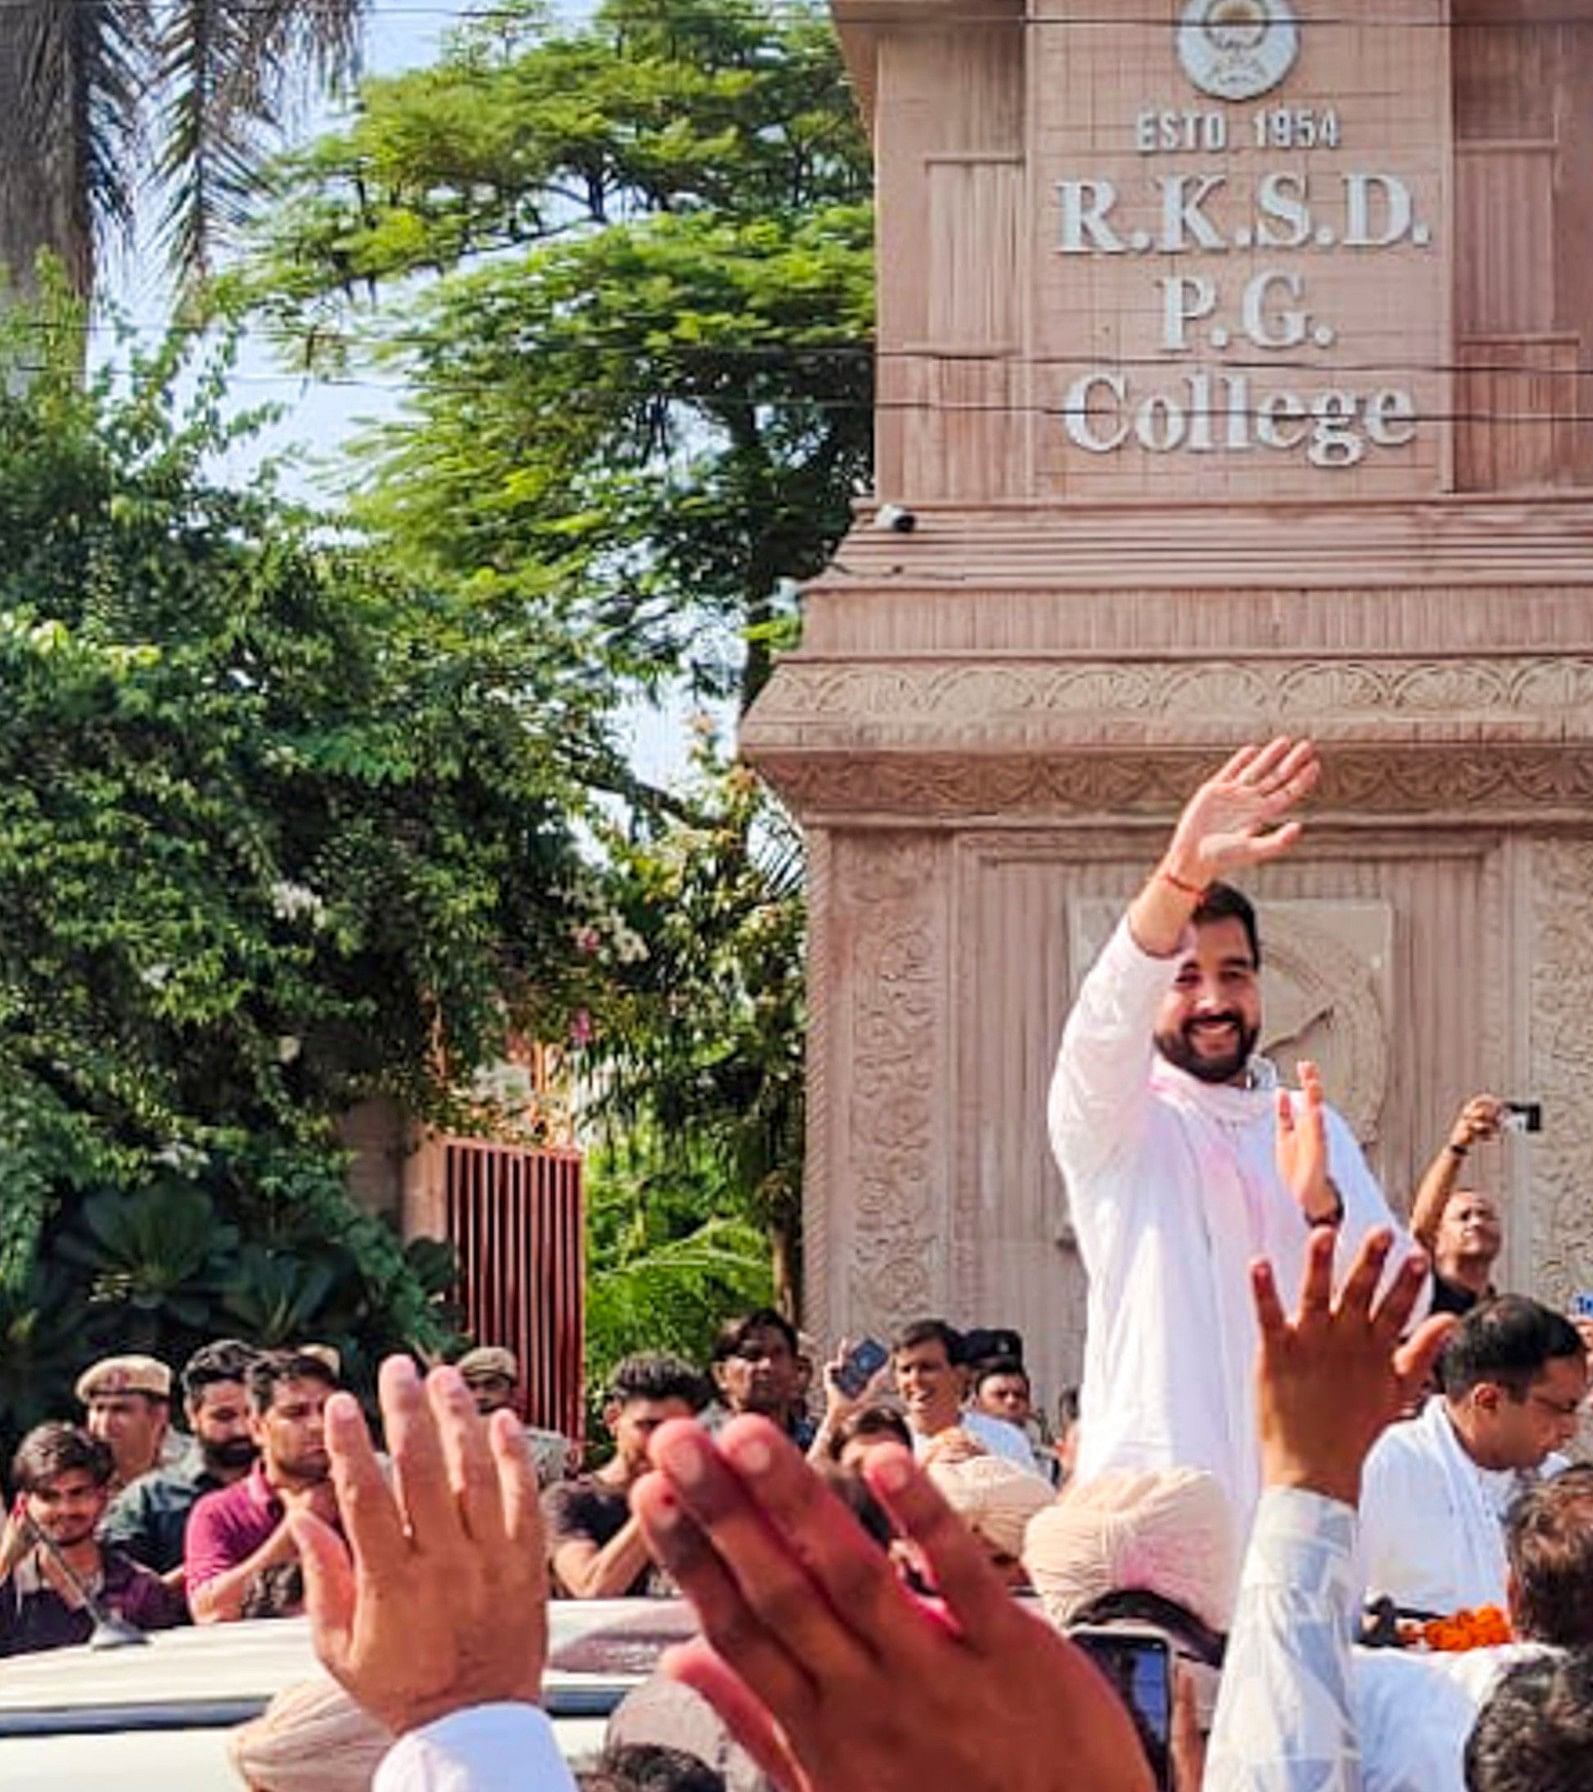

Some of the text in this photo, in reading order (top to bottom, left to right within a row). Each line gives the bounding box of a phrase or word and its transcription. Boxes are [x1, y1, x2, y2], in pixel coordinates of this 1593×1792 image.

[1253, 108, 1342, 149] 1954
[1055, 172, 1430, 253] R.K.S.D.
[1158, 270, 1335, 352] P.G.
[1063, 371, 1419, 468] College
